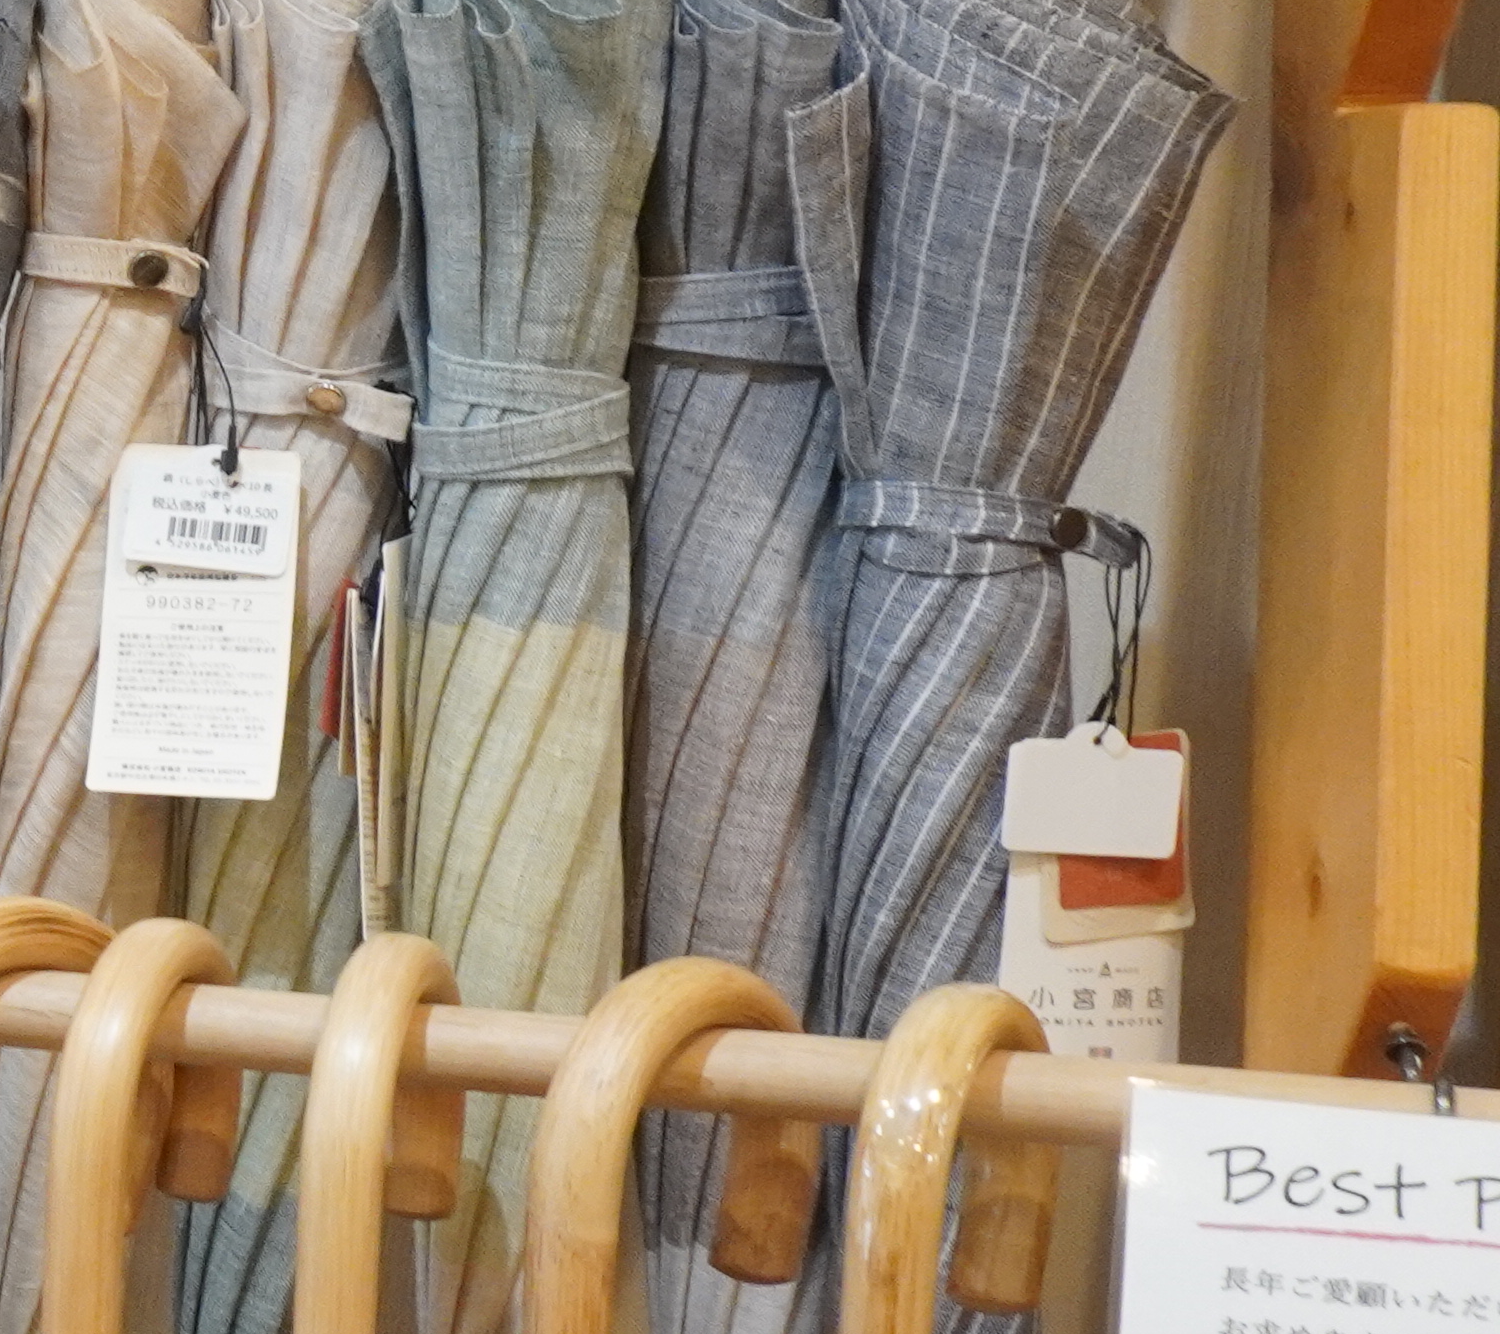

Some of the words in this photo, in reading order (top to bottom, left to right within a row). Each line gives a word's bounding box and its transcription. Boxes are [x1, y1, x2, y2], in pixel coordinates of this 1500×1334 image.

[145, 595, 253, 612] 990382-72
[1028, 986, 1165, 1012] 小宮商店
[1040, 1017, 1095, 1028] OMIYA
[1207, 1145, 1428, 1219] Best
[1221, 1266, 1500, 1323] 長年ご愛顧いただ
